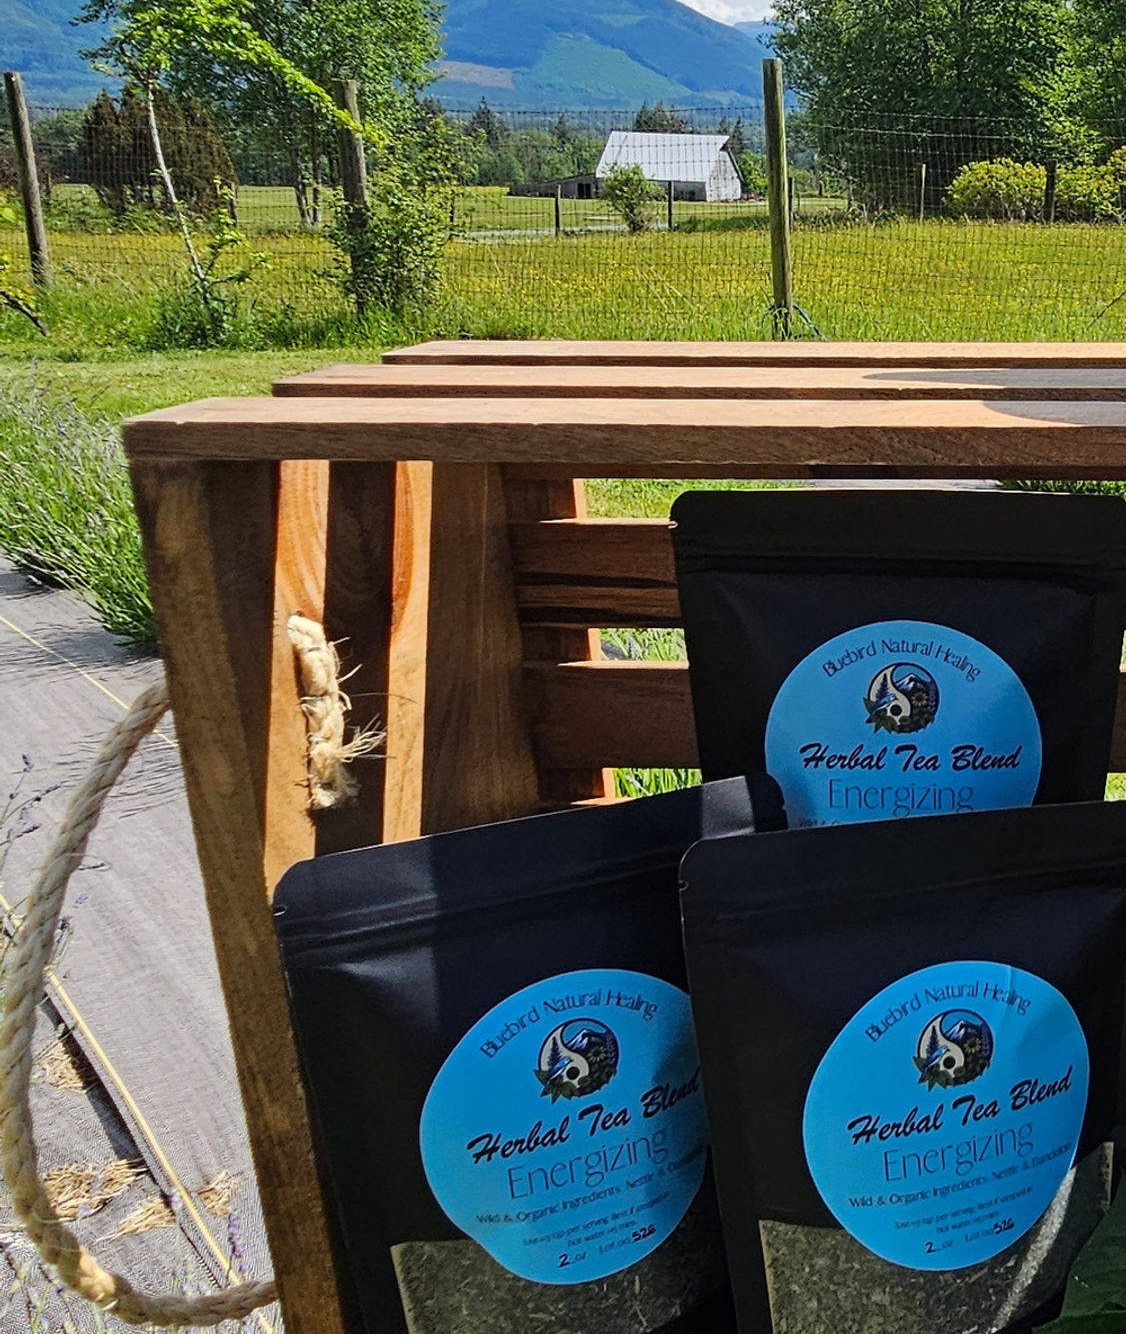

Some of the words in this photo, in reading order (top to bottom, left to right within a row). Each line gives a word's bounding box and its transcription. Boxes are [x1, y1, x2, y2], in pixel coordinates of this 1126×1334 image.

[822, 640, 877, 678] Bluebird
[881, 638, 933, 656] Natural
[935, 645, 981, 683] Healing
[799, 742, 887, 769] Herbal
[894, 744, 941, 772] Tea
[949, 744, 1023, 772] Blend
[828, 778, 975, 817] Energizing
[480, 1005, 540, 1059] Bluebird
[543, 988, 602, 1016] Natural
[606, 989, 658, 1020] Healing
[864, 994, 922, 1043] Bluebird
[925, 979, 979, 1005] Natural
[983, 982, 1031, 1016] Healing
[466, 1116, 572, 1165] Herbal
[578, 1103, 632, 1138] Tea
[639, 1067, 701, 1119] Blend
[847, 1104, 945, 1146] Herbal
[952, 1094, 1001, 1127] Tea
[1009, 1065, 1073, 1112] Blend
[508, 1127, 668, 1200] Energizing
[883, 1122, 1033, 1182] Energizing
[516, 1204, 560, 1223] Organic
[849, 1197, 874, 1208] Wild
[876, 1196, 887, 1206] &
[888, 1189, 932, 1207] Organic
[558, 1253, 570, 1268] 2
[924, 1240, 936, 1254] 2
